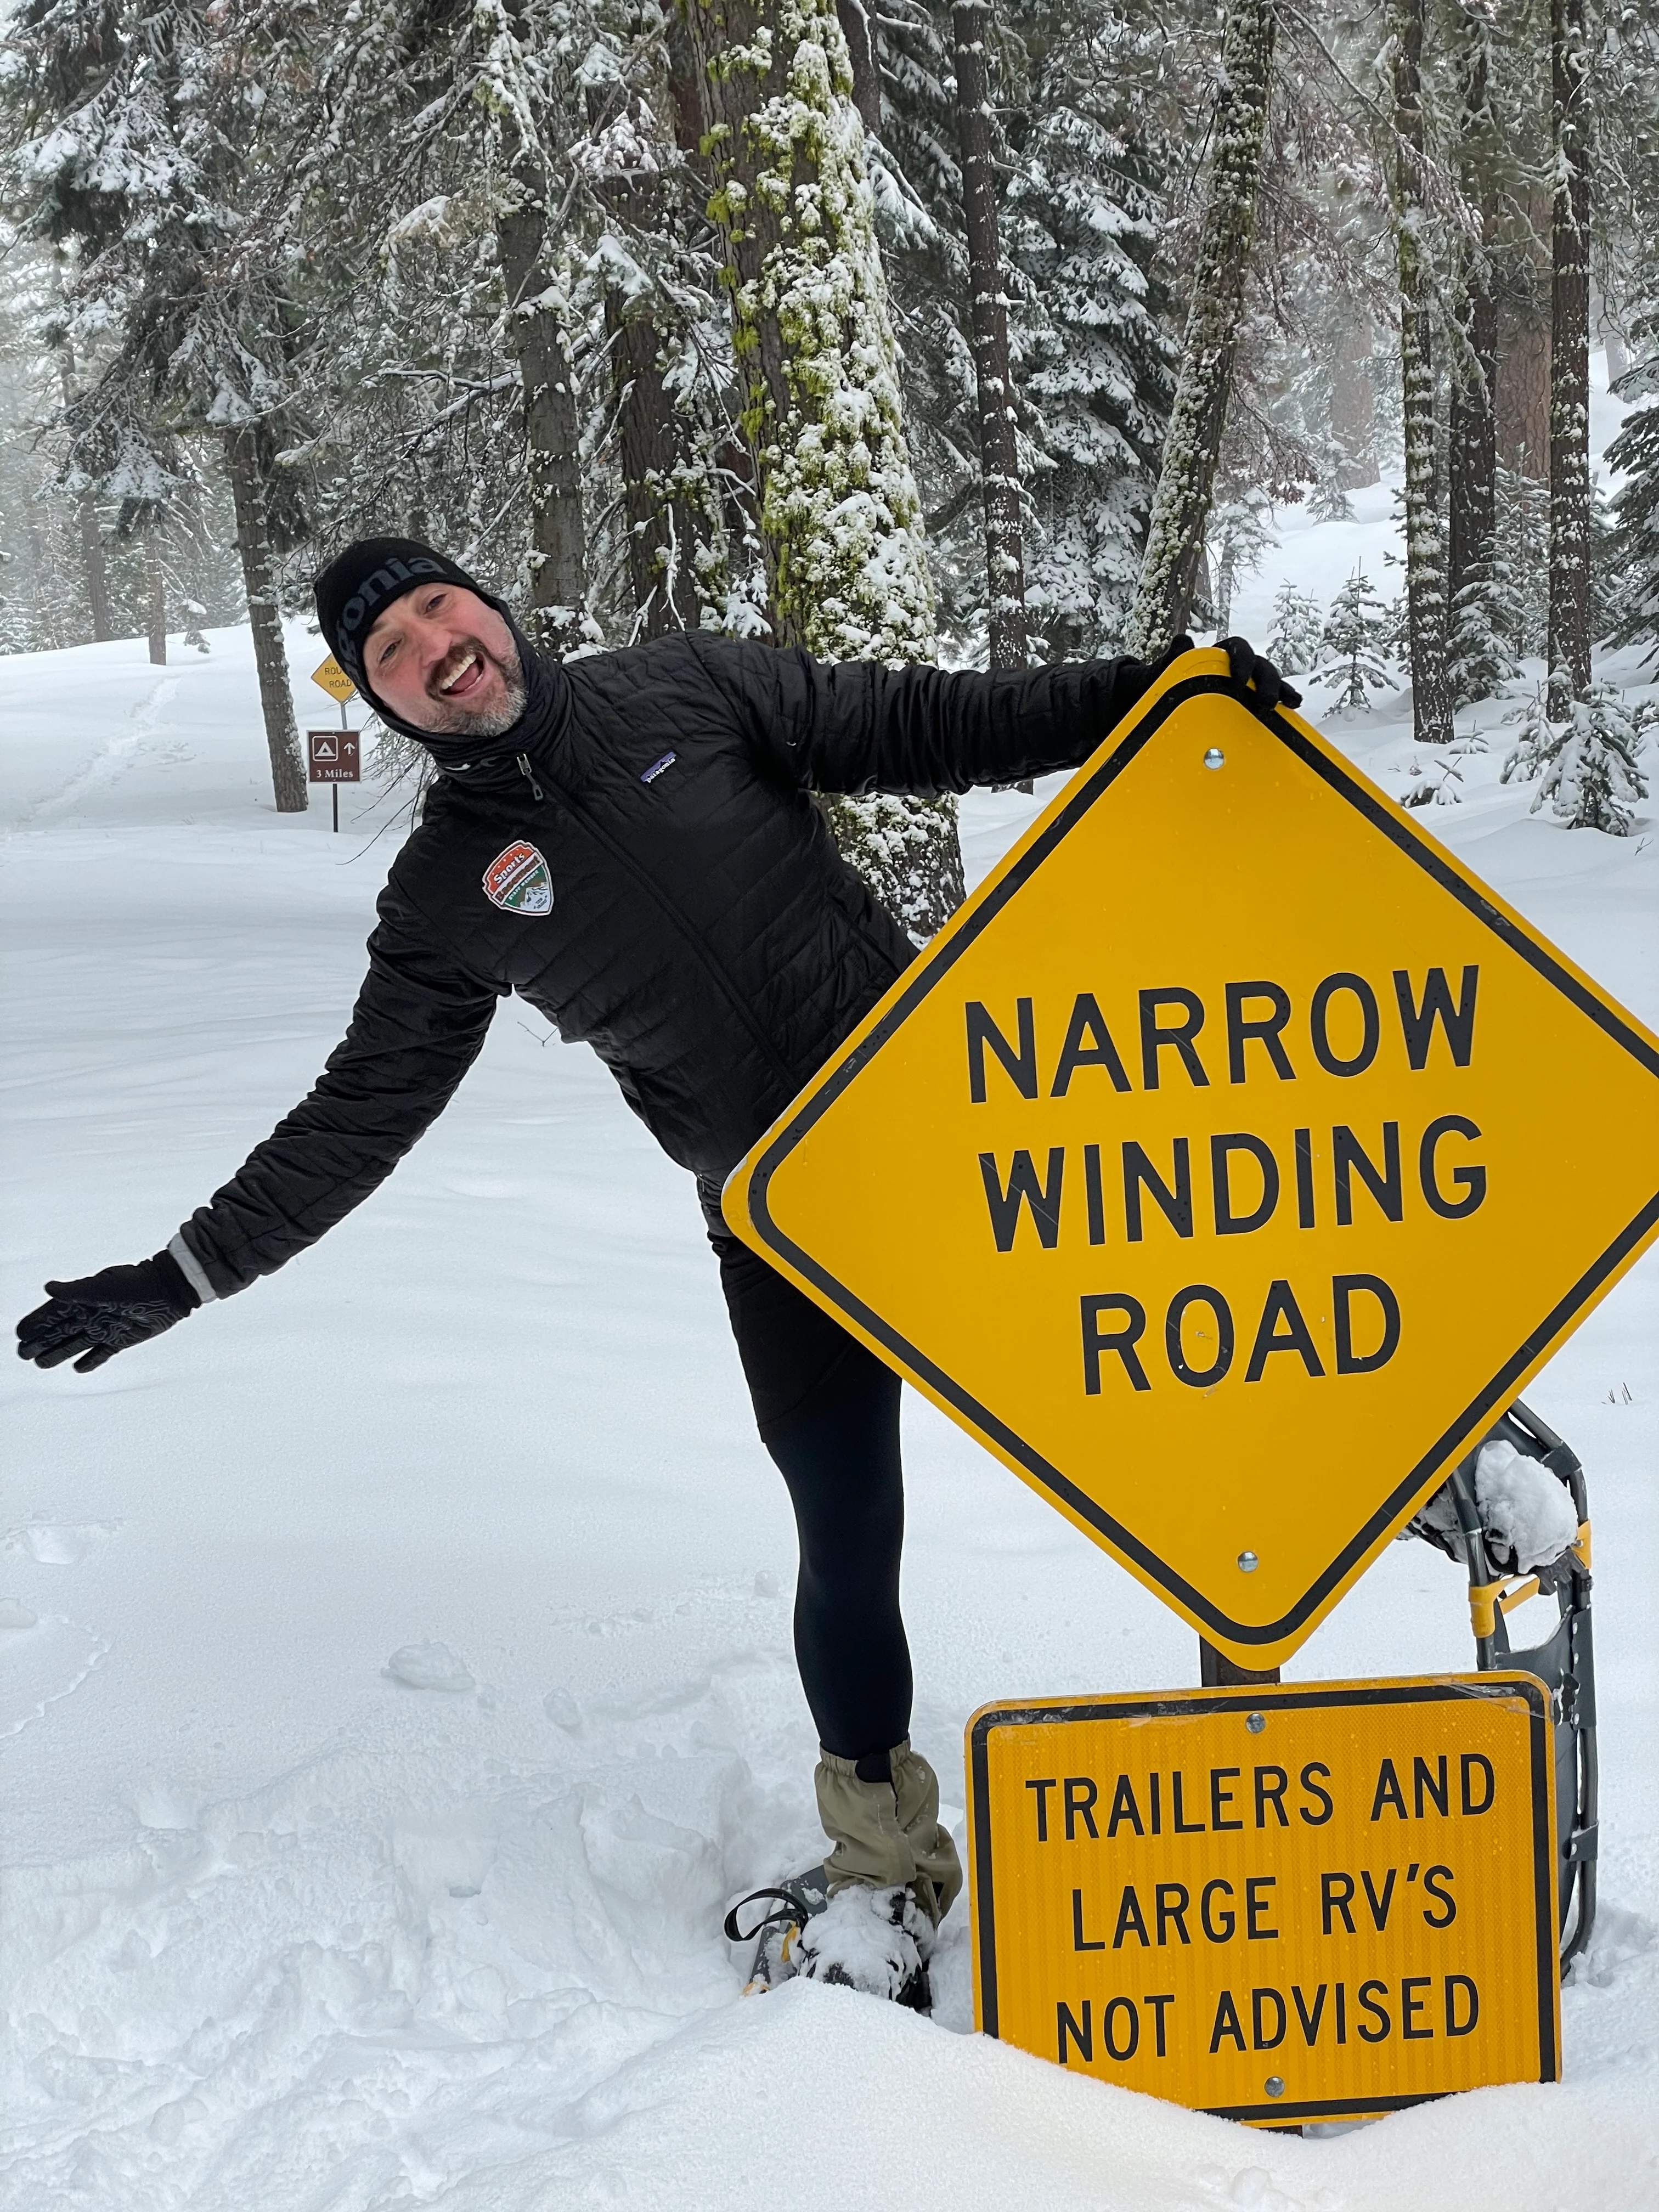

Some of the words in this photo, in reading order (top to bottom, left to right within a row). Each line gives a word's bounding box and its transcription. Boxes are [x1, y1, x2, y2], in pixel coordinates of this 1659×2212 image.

[325, 667, 342, 675] ROU
[329, 679, 352, 688] ROAD
[316, 770, 322, 778] 3
[324, 769, 353, 778] Miles
[646, 758, 676, 783] patagonia
[494, 853, 525, 884] Sports
[965, 964, 1479, 1103] NARROW
[978, 1115, 1486, 1252] WINDING
[1080, 1273, 1401, 1396] ROAD
[1025, 1762, 1333, 1842] TRAILERS
[1370, 1753, 1495, 1821] AND
[1072, 1876, 1279, 1951] LARGE
[1321, 1863, 1457, 1935] RV'S
[1057, 1994, 1175, 2064] NOT
[1209, 1974, 1479, 2053] ADVISED
